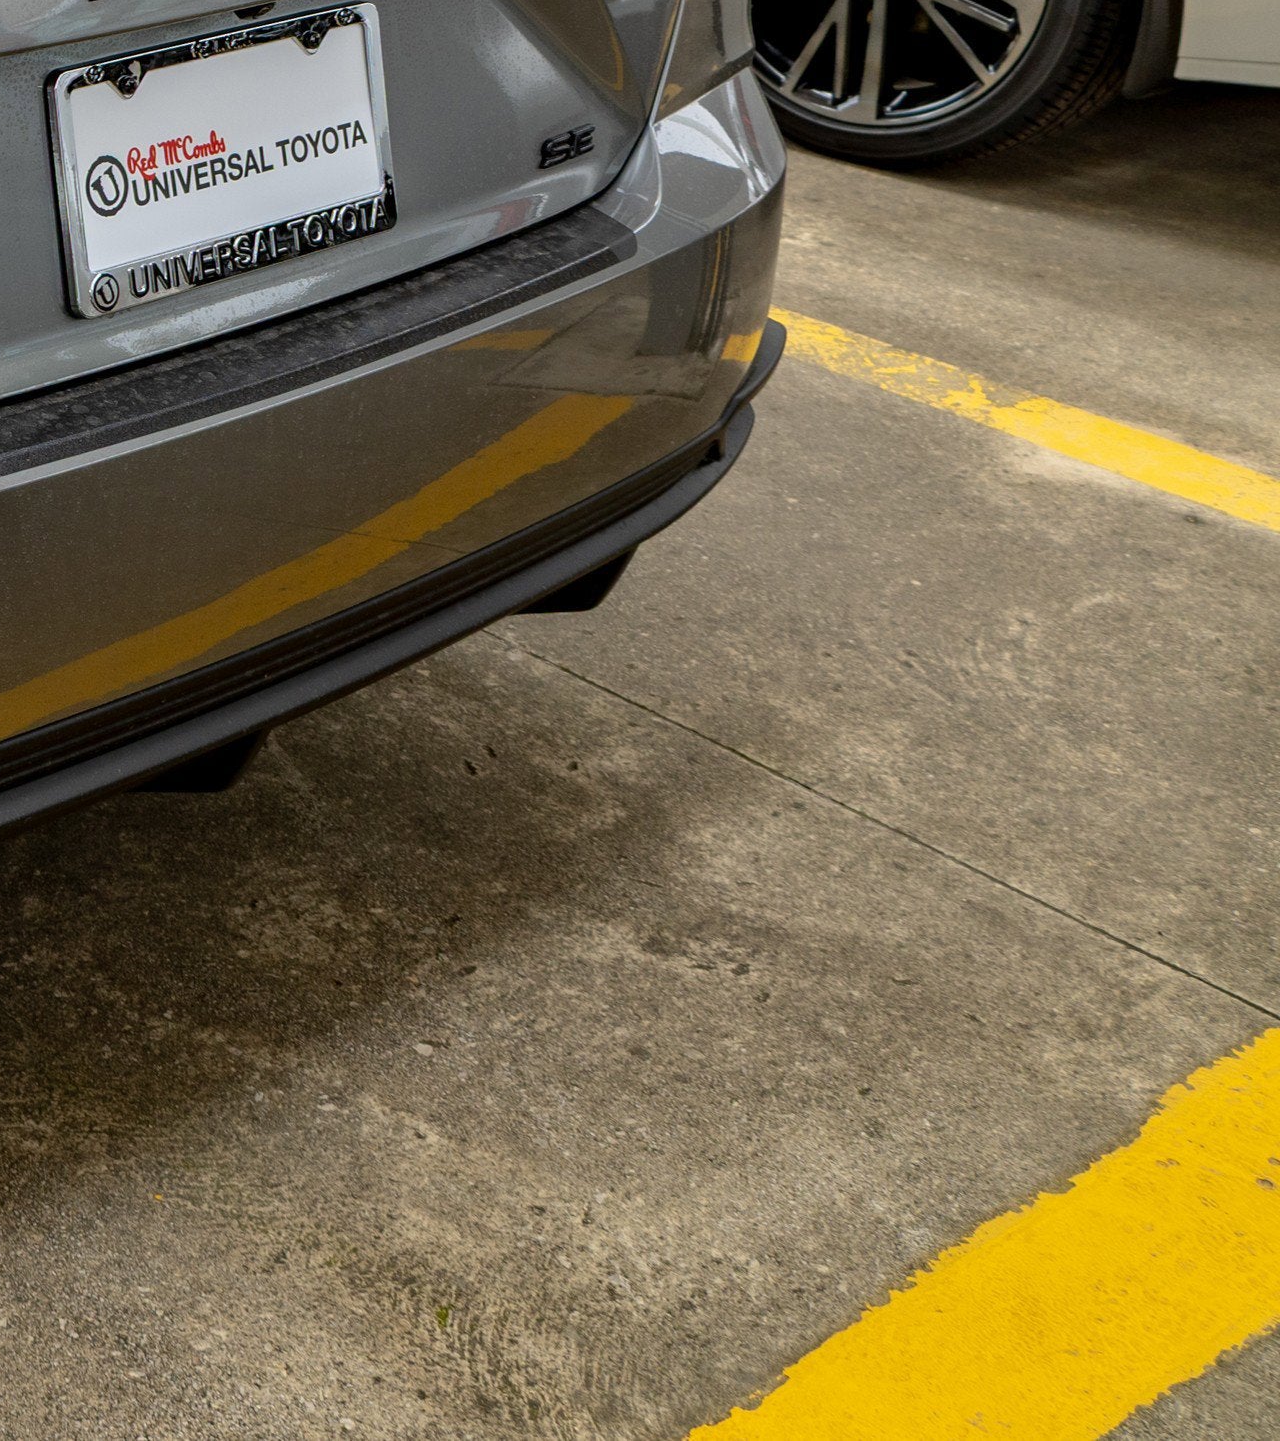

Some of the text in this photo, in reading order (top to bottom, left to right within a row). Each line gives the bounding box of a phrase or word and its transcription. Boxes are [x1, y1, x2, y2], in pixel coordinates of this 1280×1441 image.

[127, 130, 226, 181] Red McCombs
[131, 119, 368, 207] UNIVERSAL TOYOTA
[540, 123, 596, 170] SE
[127, 196, 390, 298] UNIVERSAL TOYOTA
